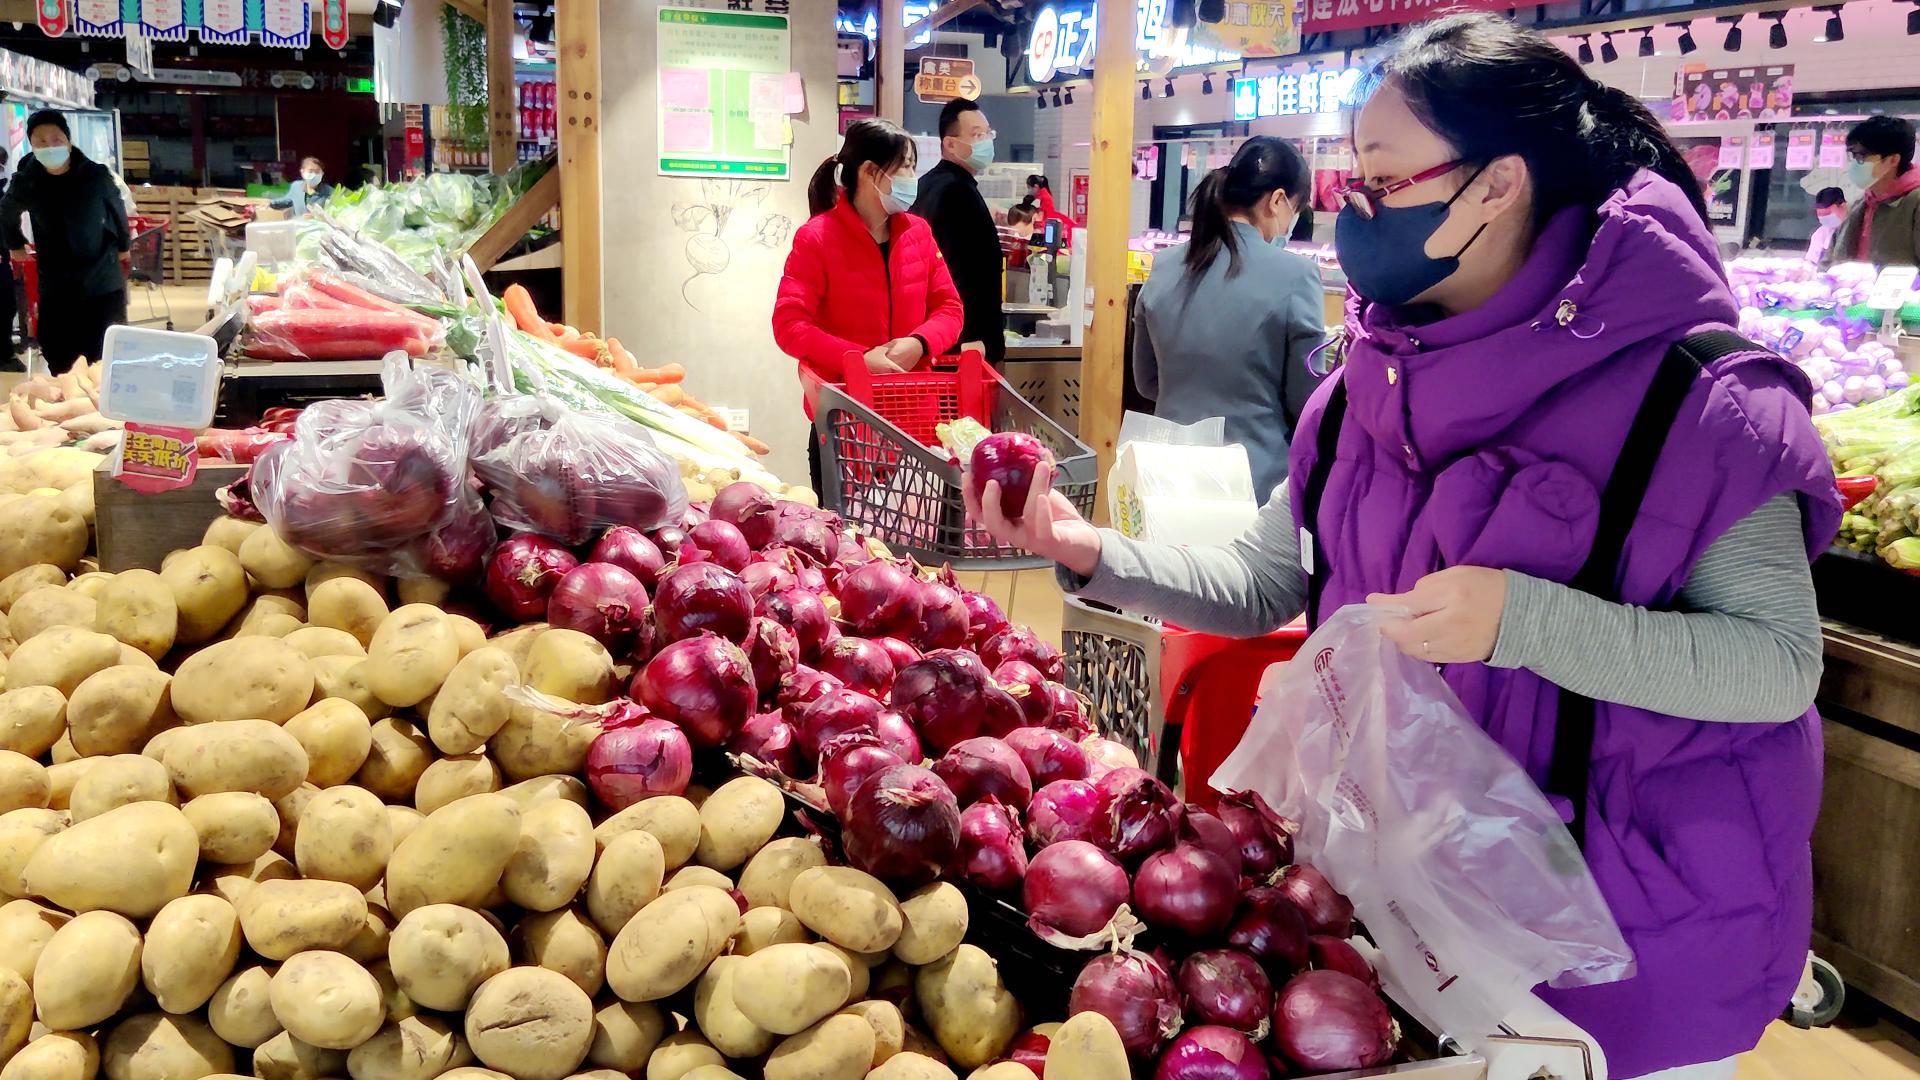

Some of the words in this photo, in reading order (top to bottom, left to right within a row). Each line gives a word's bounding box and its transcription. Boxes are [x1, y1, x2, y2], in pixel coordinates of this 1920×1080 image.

[1034, 30, 1053, 59] CP
[919, 76, 957, 92] 称重台
[123, 449, 190, 476] 天天低价
